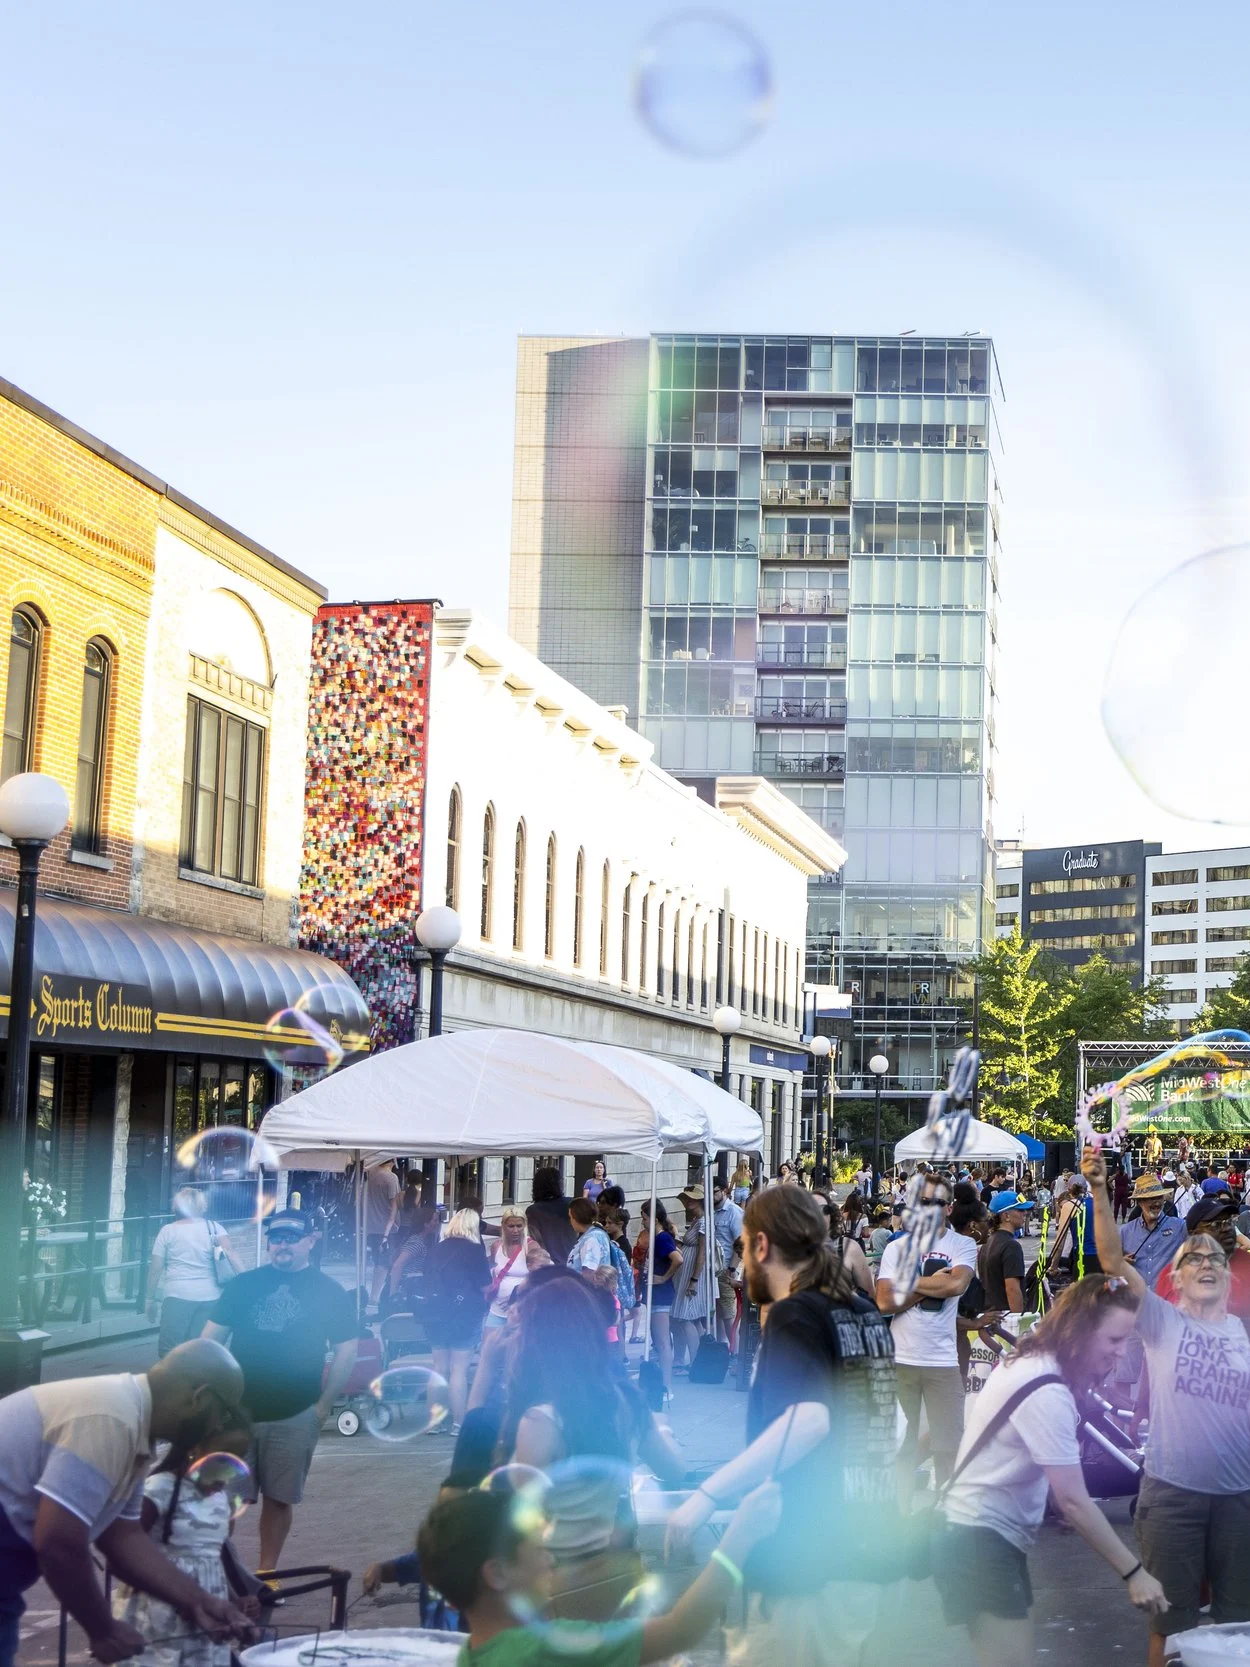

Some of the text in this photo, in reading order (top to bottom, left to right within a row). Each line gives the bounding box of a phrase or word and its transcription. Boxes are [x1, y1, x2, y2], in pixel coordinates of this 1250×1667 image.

[1063, 850, 1099, 876] Graduate
[37, 974, 152, 1037] Sports Column
[1160, 1089, 1195, 1102] Bank
